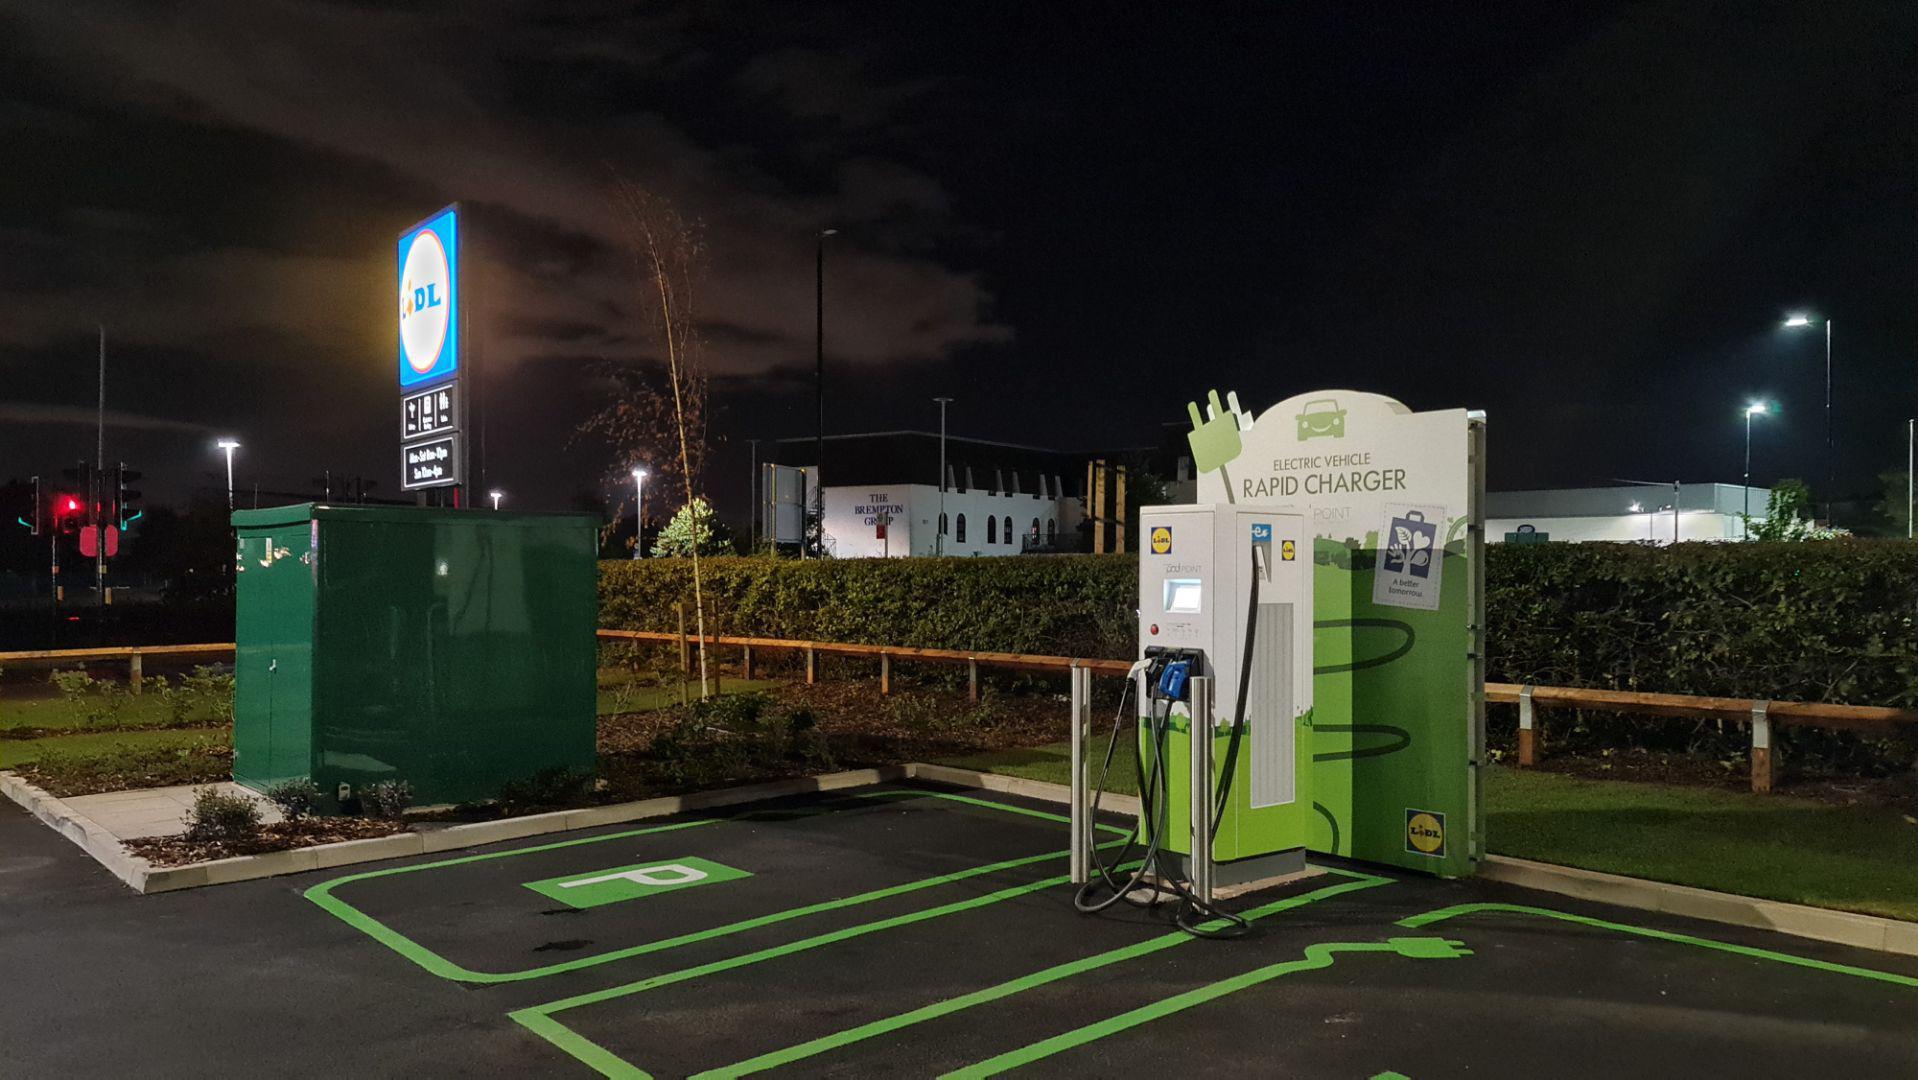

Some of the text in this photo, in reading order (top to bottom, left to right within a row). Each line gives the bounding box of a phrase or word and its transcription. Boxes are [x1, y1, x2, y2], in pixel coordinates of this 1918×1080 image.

[1273, 452, 1371, 471] ELECTRIC VEHICLE
[1243, 469, 1406, 498] RAPID CHARGER
[869, 494, 888, 503] THE
[855, 505, 903, 514] BREMPTON
[1313, 506, 1352, 520] POINT
[864, 516, 893, 525] GRP
[1399, 579, 1420, 588] better
[1388, 587, 1423, 598] tomorrow
[558, 864, 708, 888] P
